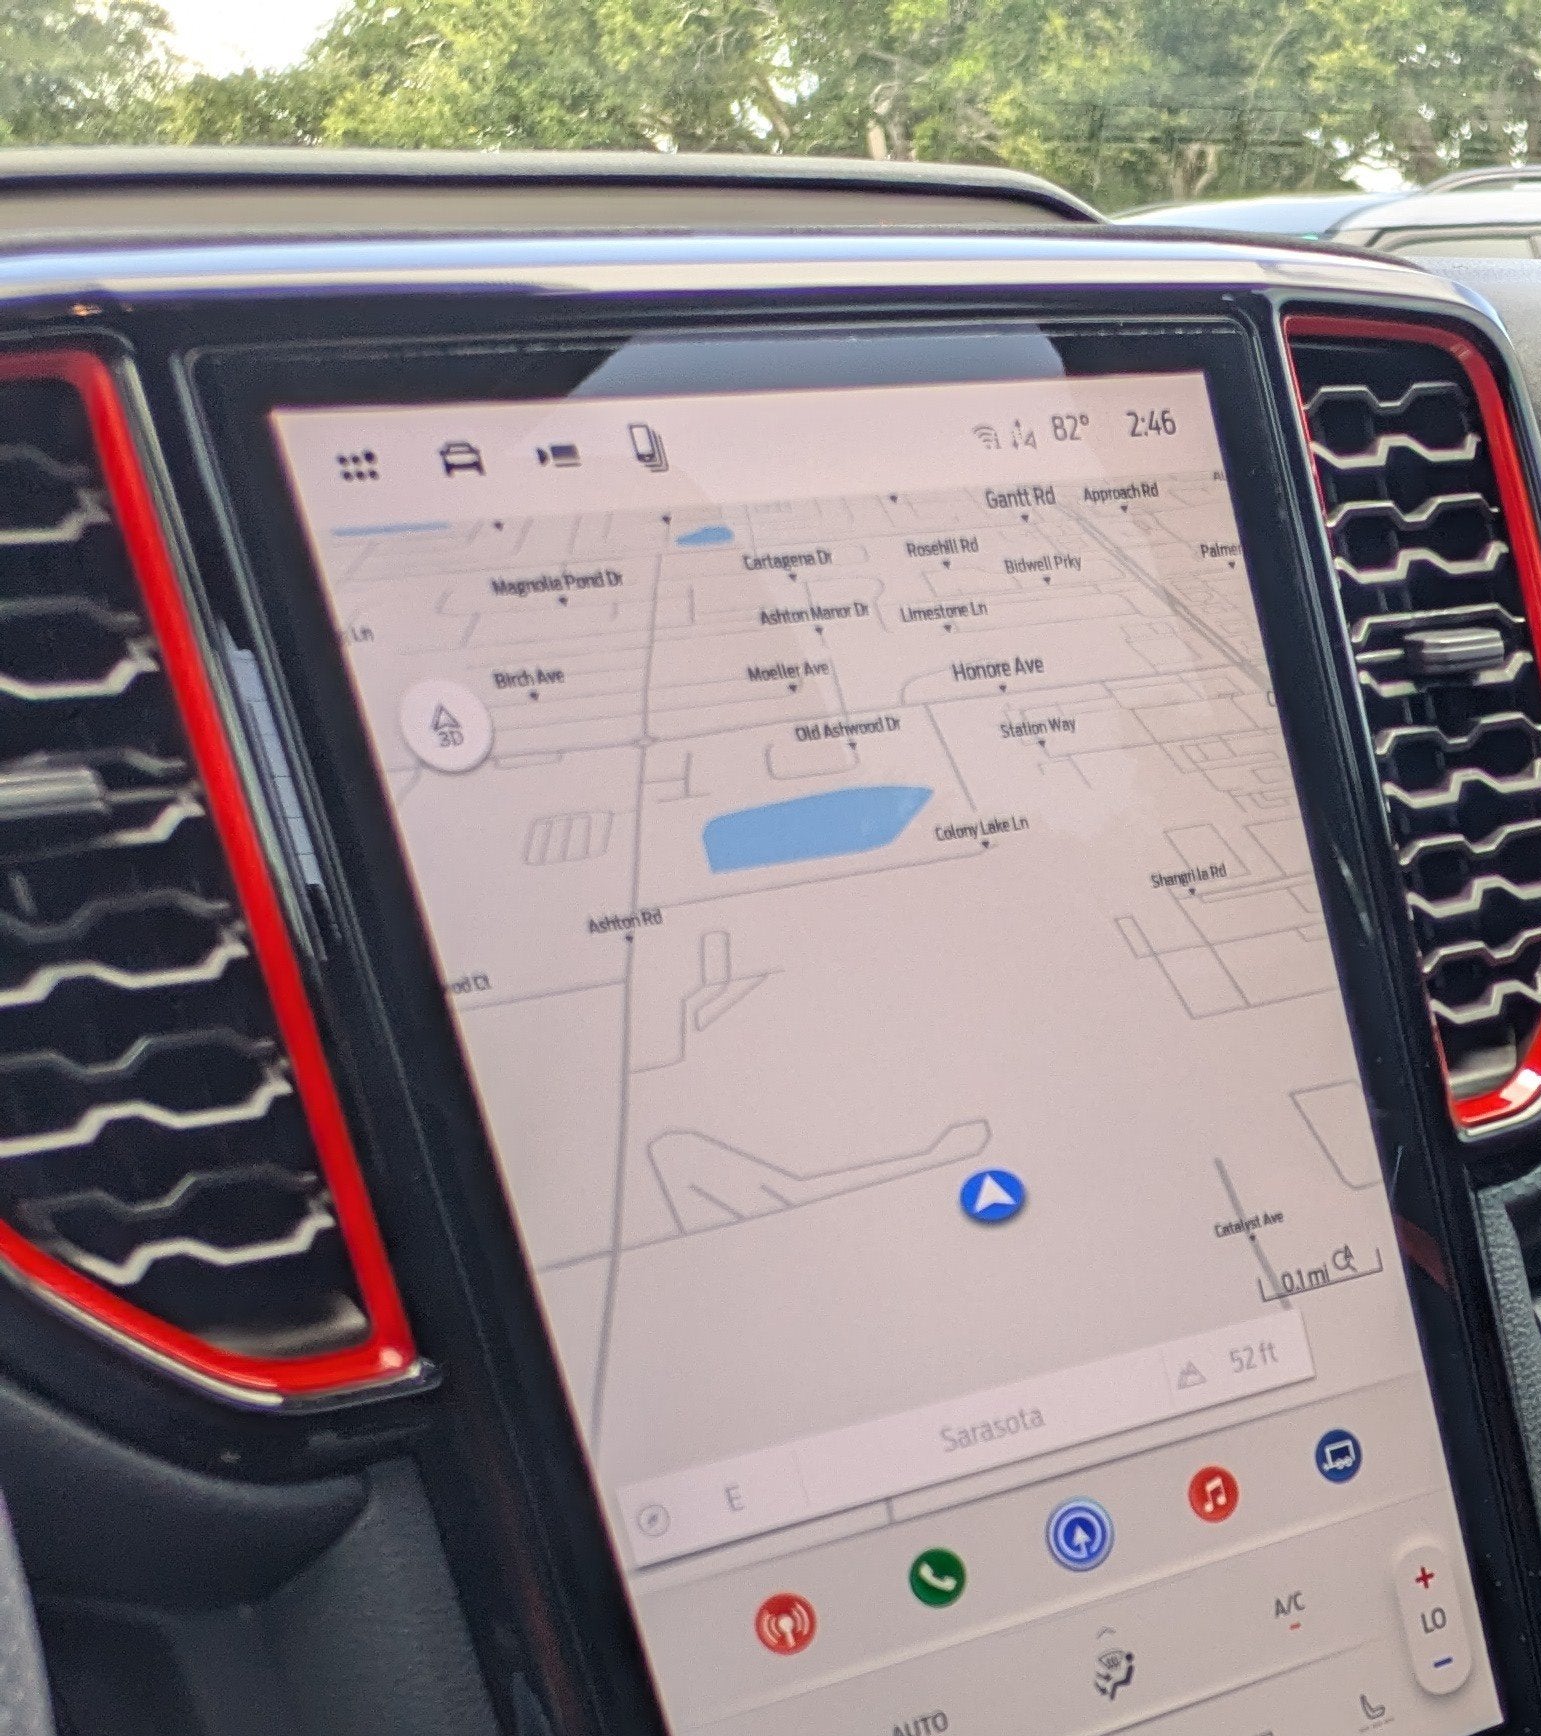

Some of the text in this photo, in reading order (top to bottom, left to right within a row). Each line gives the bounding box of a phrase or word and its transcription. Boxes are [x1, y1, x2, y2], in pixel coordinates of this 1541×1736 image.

[1052, 413, 1090, 441] 82°
[1126, 410, 1177, 437] 2:46
[985, 486, 1056, 510] Gantt Rd
[1083, 482, 1159, 505] Approach Rd
[743, 549, 833, 571] Cartagena Dr
[906, 537, 979, 557] Rosehill Rd
[1004, 557, 1051, 574] Bidwell
[490, 569, 624, 597] Magnolia Pond Dr
[760, 602, 870, 626] Ashton Manor Dr
[900, 601, 988, 623] Limestone Ln
[493, 668, 565, 690] Birch Ave
[747, 661, 830, 682] Moeller Ave
[951, 656, 1045, 682] Honore Ave
[795, 715, 901, 742] Old Ashwood Dr
[1000, 717, 1077, 740] Station Way
[935, 814, 1029, 842] Colony Lake Ln
[1150, 869, 1196, 888] Shangri
[1209, 862, 1228, 879] Rd
[588, 908, 663, 934] Ashton Rd
[1263, 1212, 1284, 1226] Ave
[1281, 1262, 1330, 1293] 0.1 mi
[1229, 1341, 1280, 1373] 52 ft
[940, 1405, 1046, 1454] Sarasota
[725, 1486, 745, 1512] E
[1274, 1591, 1306, 1619] A/C
[1421, 1606, 1447, 1634] LO
